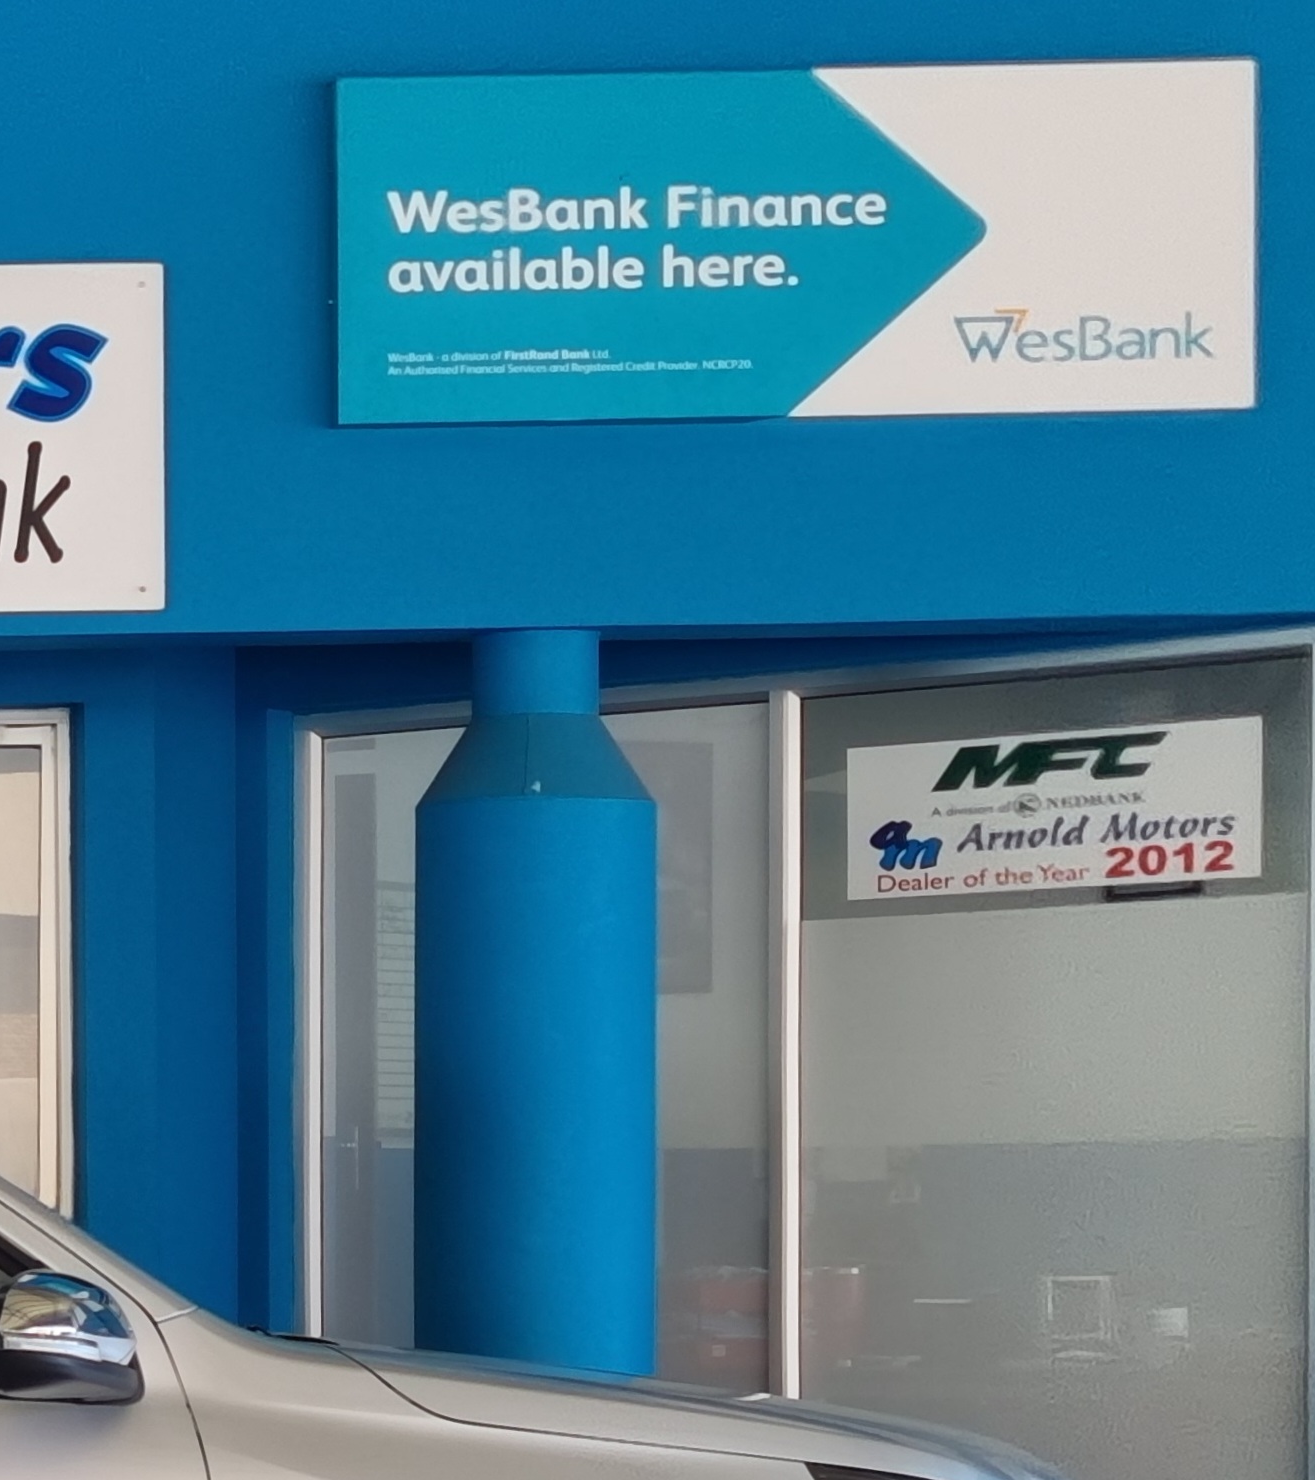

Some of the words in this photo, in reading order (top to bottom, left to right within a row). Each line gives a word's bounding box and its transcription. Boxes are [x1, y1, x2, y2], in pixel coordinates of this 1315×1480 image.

[387, 188, 648, 235] WesBank
[667, 184, 887, 228] Finance
[388, 247, 644, 293] available
[663, 244, 799, 289] here.
[387, 352, 433, 362] WesBank
[442, 354, 449, 362] a
[451, 352, 489, 361] division
[491, 350, 501, 360] of
[561, 349, 589, 359] Bank
[954, 308, 1214, 365] WesBank
[388, 366, 402, 375] An
[460, 364, 505, 374] Financial
[507, 363, 547, 373] Services
[549, 363, 569, 373] and
[571, 362, 623, 375] Registered
[625, 361, 655, 371] Credit
[931, 731, 1168, 792] MFC
[932, 807, 941, 817] A
[946, 805, 993, 816] division
[1046, 791, 1146, 810] NEDBANK
[957, 816, 1090, 853] Arnold
[1100, 812, 1236, 844] Motors
[877, 874, 954, 893] Dealer
[963, 868, 988, 888] of
[995, 867, 1033, 885] the
[1038, 863, 1090, 883] Year
[1105, 841, 1235, 878] 2012
